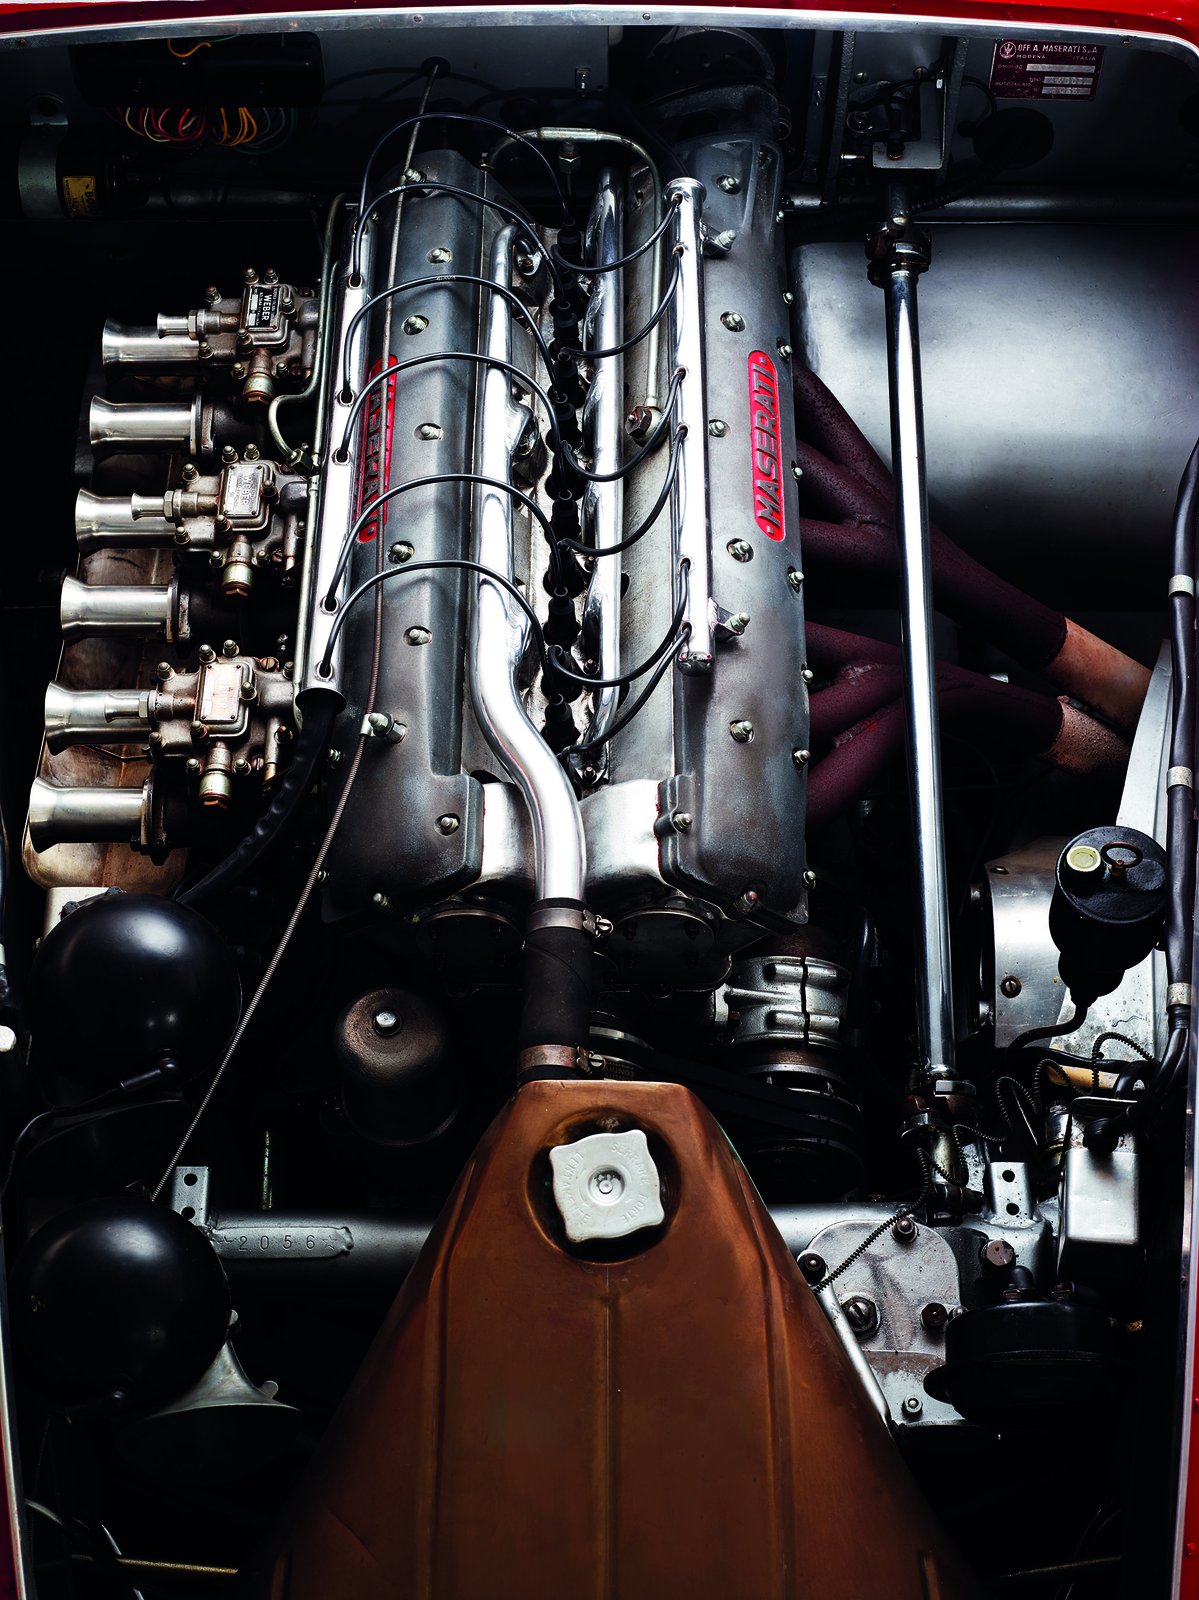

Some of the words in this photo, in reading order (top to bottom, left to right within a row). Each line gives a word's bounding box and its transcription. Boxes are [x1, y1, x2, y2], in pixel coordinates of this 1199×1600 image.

[1042, 45, 1081, 53] MASERATI
[261, 294, 273, 321] WEBER
[751, 362, 780, 526] MASERATI
[241, 476, 252, 505] WEBER
[238, 1234, 316, 1251] 2056
